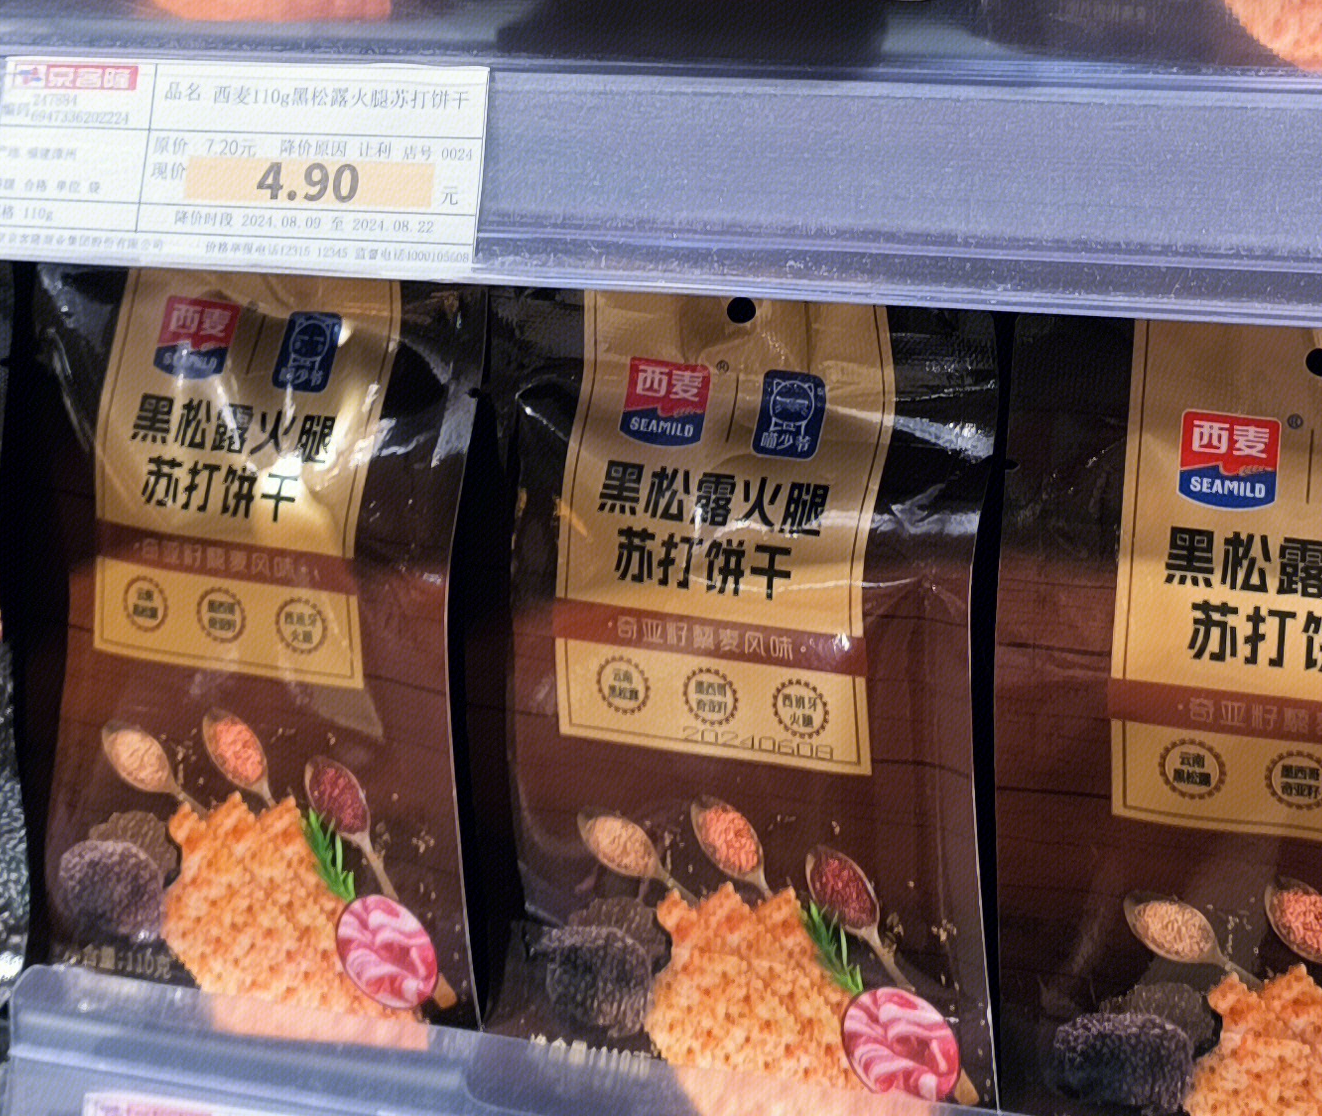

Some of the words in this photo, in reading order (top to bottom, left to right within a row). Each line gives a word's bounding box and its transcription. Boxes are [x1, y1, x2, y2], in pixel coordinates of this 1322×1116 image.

[164, 82, 201, 101] 品名
[153, 136, 188, 155] 原价
[280, 139, 346, 158] 降价原因
[358, 142, 392, 159] 让利
[403, 145, 432, 160] 店号
[441, 148, 472, 161] 0024
[151, 161, 186, 181] 现价
[256, 161, 360, 203] 4.90
[440, 186, 458, 206] 元
[174, 211, 233, 228] 降价时段
[331, 217, 344, 231] 至
[352, 218, 434, 234] 2024.08.22
[317, 247, 347, 259] 12345
[167, 303, 232, 338] 西麦
[635, 365, 704, 402] 西麦
[129, 392, 337, 465] 黑松露火腿
[629, 416, 694, 438] SEAMILD
[1192, 419, 1270, 459] 西麦
[141, 456, 299, 523] 苏打饼干
[597, 460, 830, 537] 黑松露火腿
[1189, 476, 1266, 498] SEAMILD
[614, 526, 792, 600] 苏打饼干
